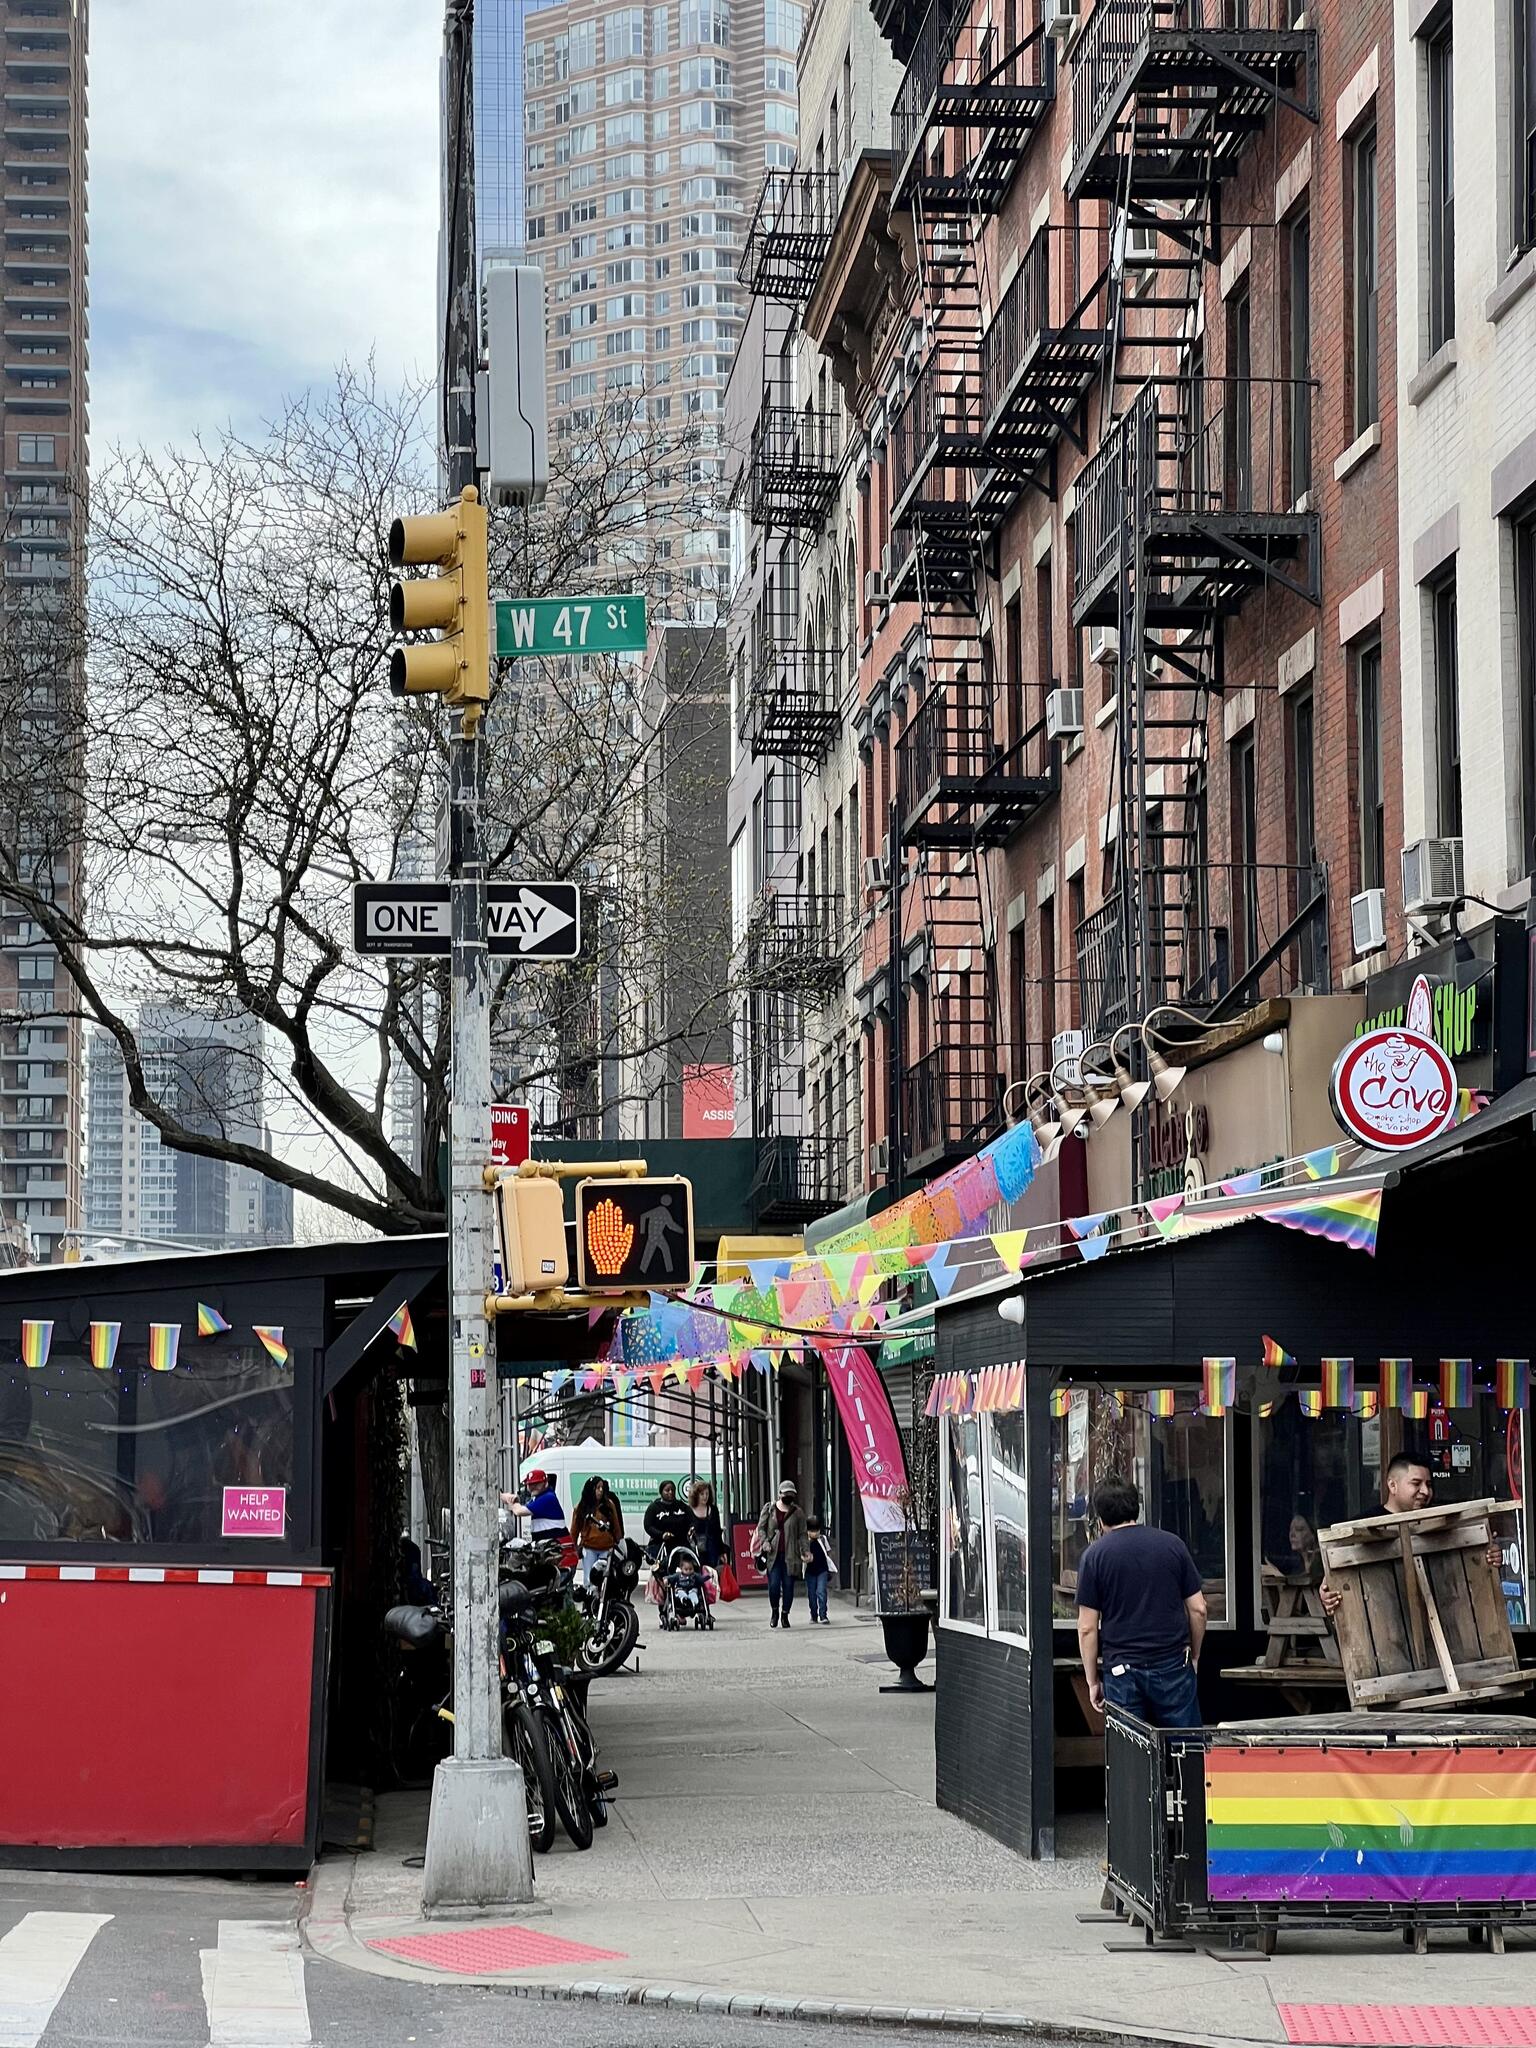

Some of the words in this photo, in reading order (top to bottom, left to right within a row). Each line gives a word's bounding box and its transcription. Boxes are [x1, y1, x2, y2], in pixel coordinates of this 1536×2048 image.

[510, 608, 536, 649] W
[552, 605, 592, 646] 47
[606, 604, 628, 630] St
[374, 905, 439, 933] ONE
[1433, 982, 1477, 1058] SHOP
[1364, 1052, 1386, 1076] the
[1359, 1075, 1446, 1117] Cave
[702, 1109, 735, 1121] ASSIS
[240, 1493, 269, 1506] HELP
[227, 1508, 281, 1521] WANTED
